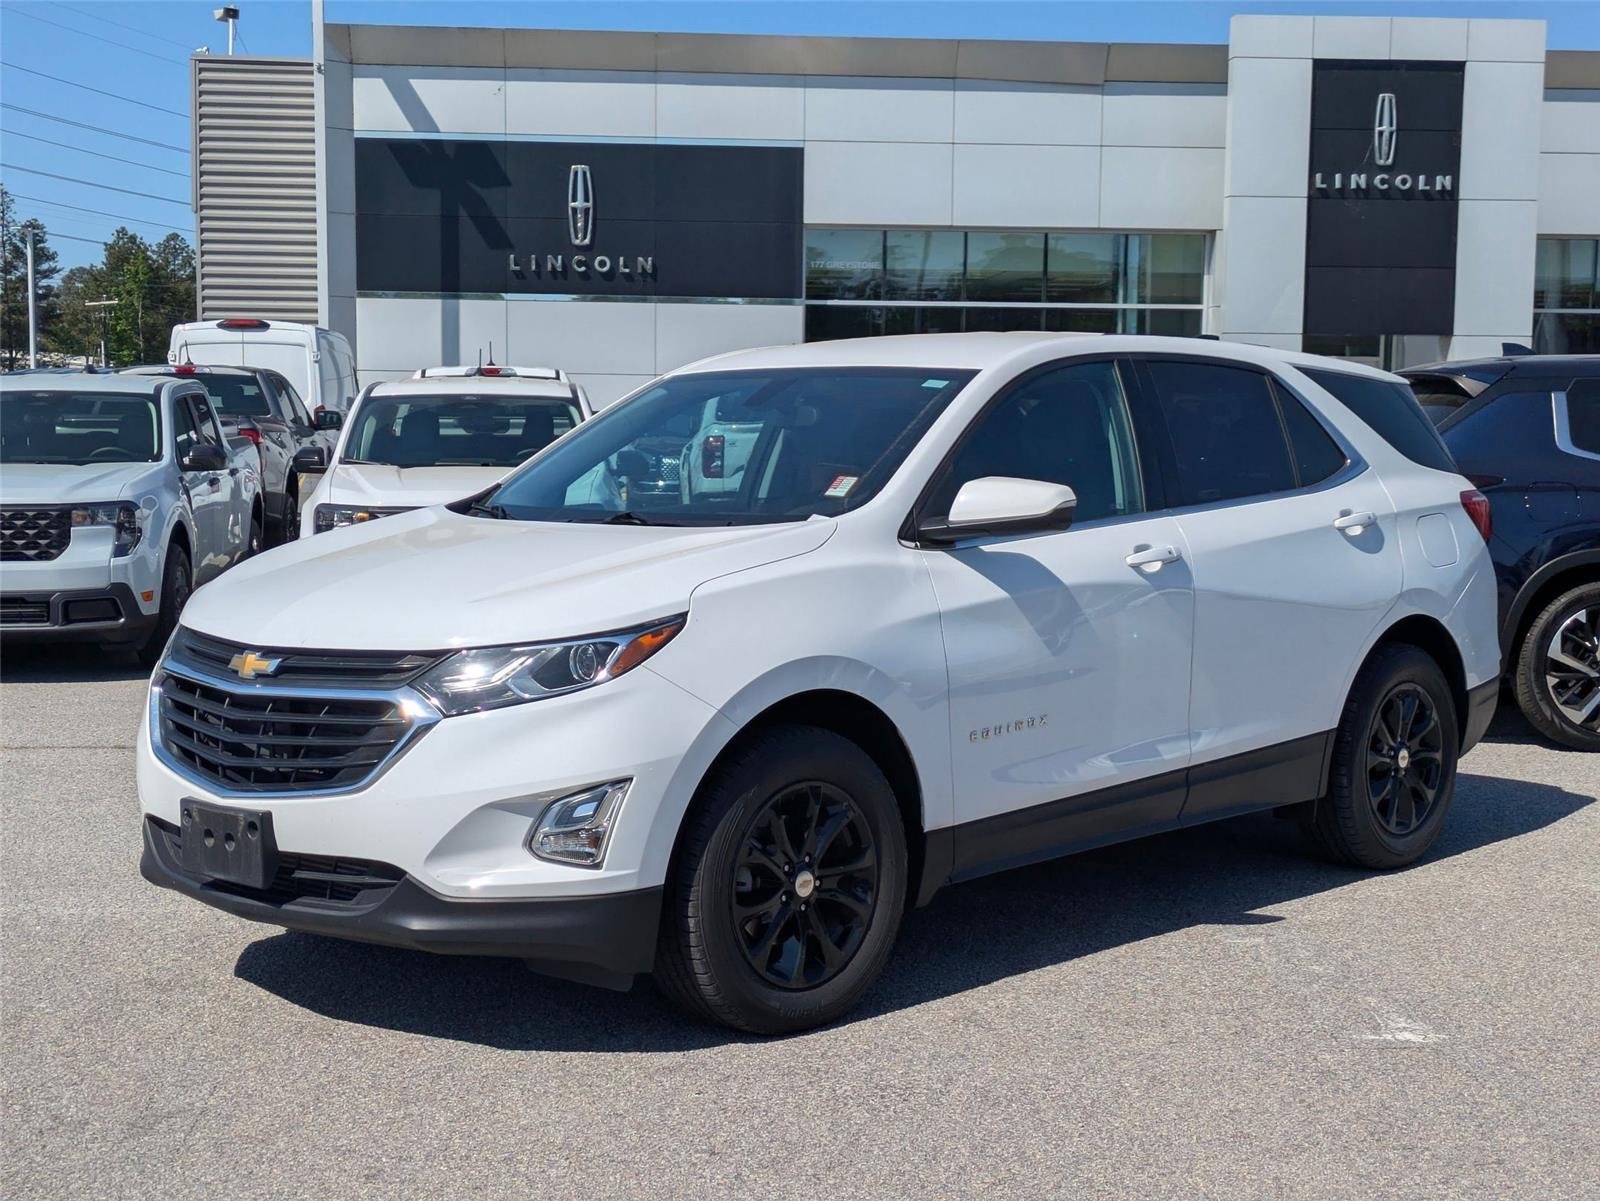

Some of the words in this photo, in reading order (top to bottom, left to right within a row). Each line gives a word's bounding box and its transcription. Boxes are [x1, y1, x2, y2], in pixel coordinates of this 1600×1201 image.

[1315, 173, 1452, 191] LINCOLN
[509, 254, 653, 273] LINCOLN
[969, 713, 1048, 742] EQUINOX
